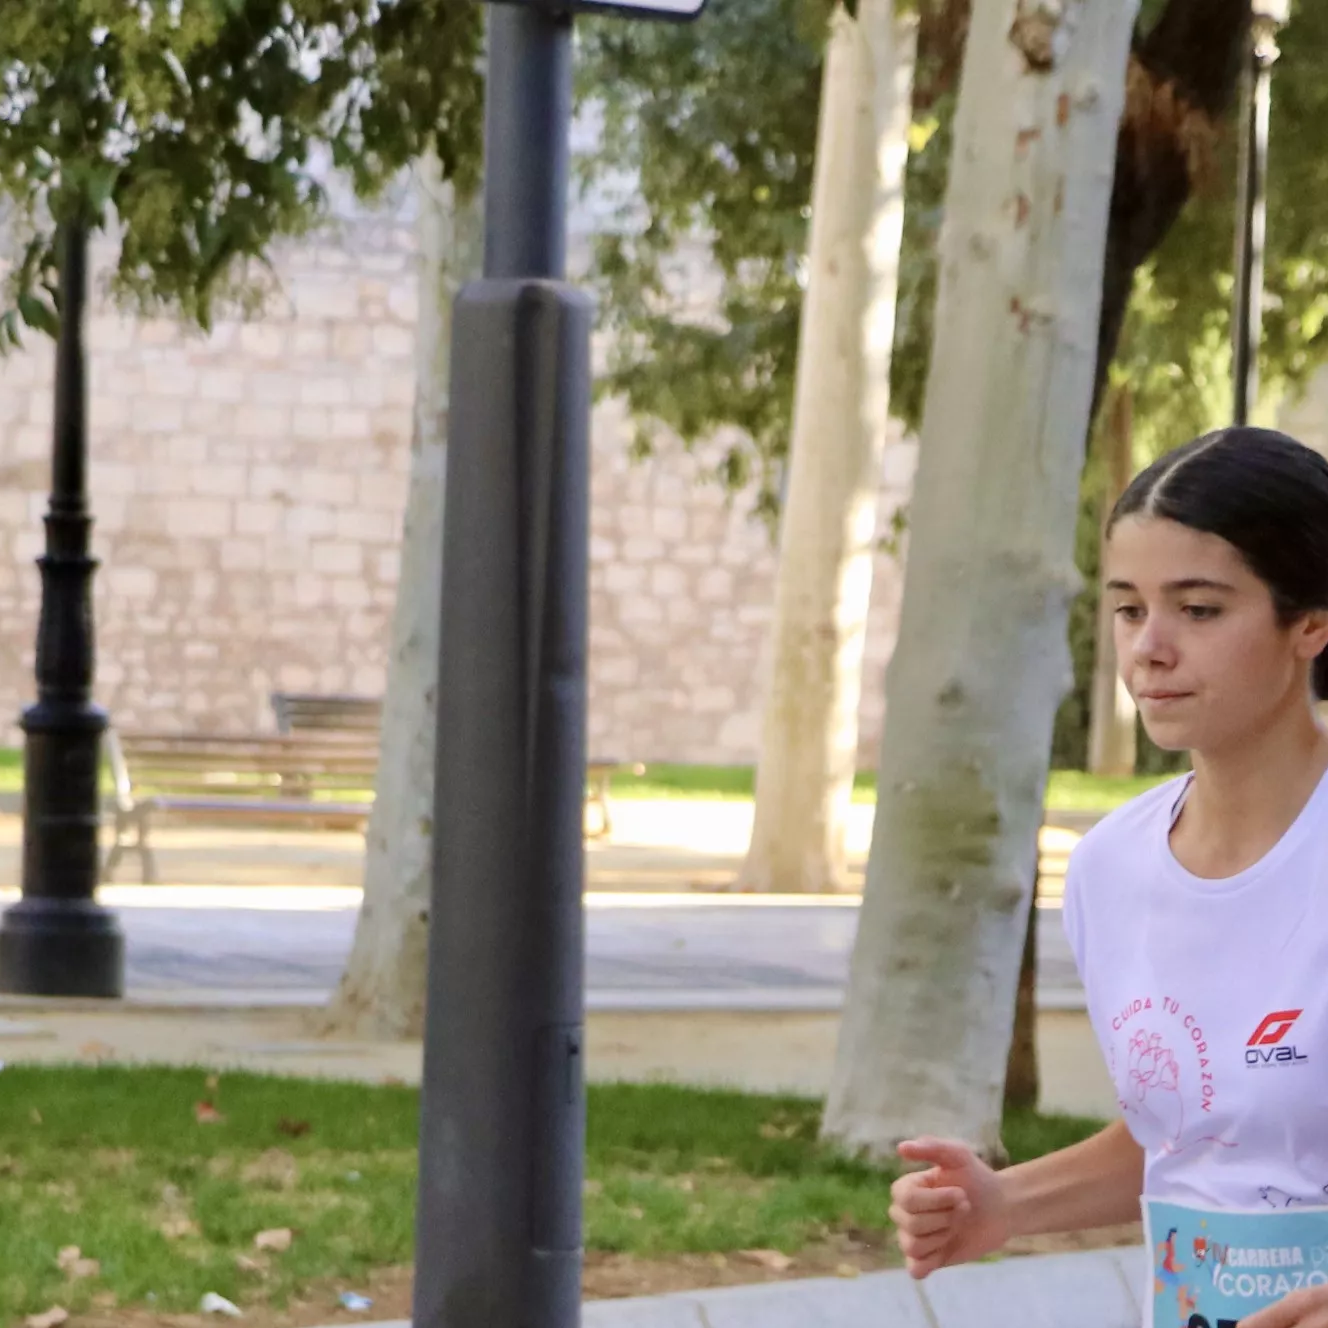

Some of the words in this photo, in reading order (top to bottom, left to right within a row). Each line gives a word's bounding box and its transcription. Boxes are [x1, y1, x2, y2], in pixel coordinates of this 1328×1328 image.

[1111, 997, 1153, 1031] CUIDA
[1162, 996, 1180, 1015] TU
[1183, 1014, 1215, 1113] CORAZÓN
[1227, 1246, 1304, 1268] CARRERA
